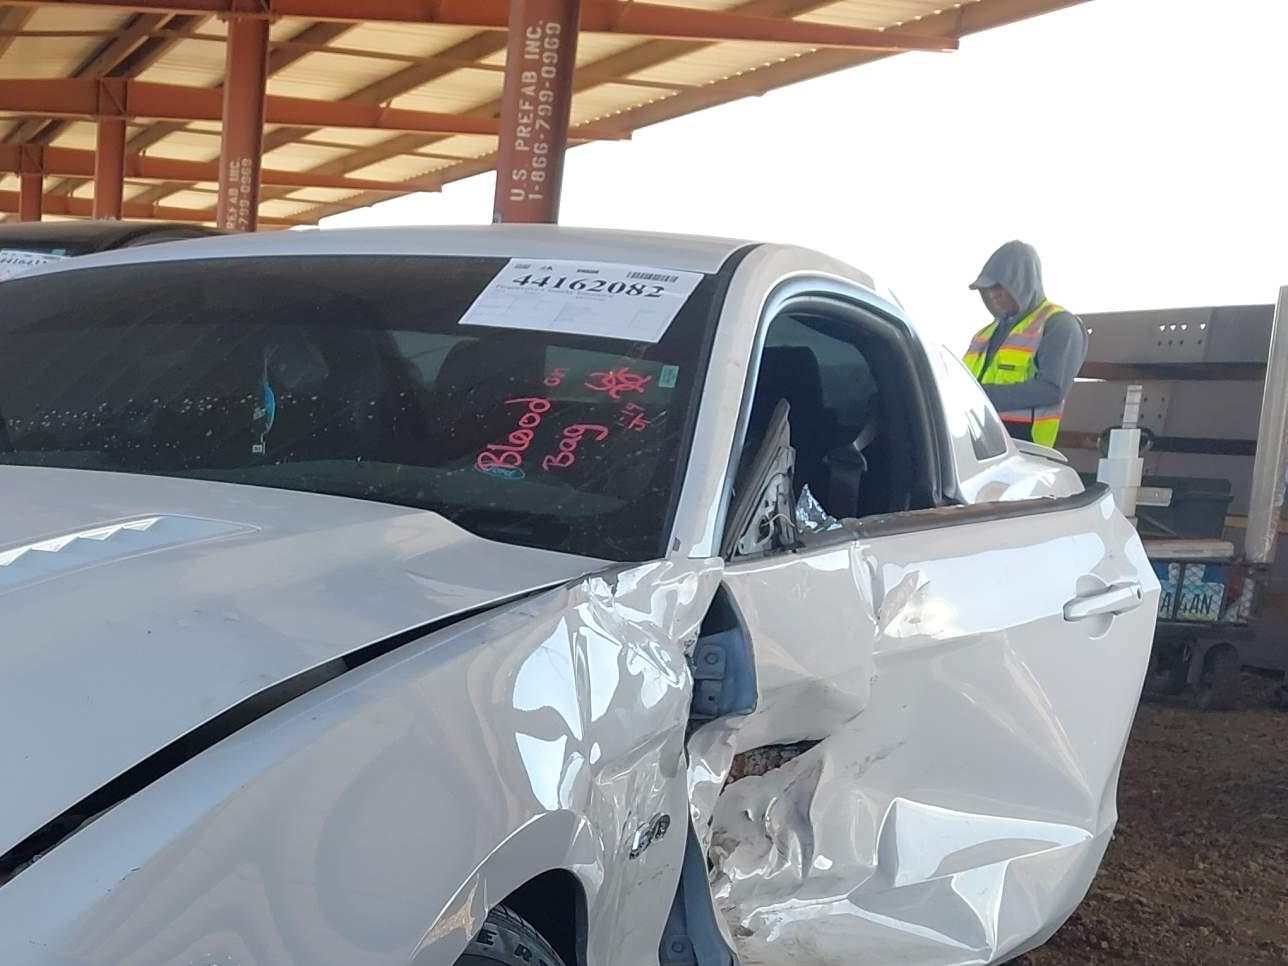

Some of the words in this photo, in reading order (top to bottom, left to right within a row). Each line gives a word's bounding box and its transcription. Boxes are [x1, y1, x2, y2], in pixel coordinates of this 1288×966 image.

[524, 20, 545, 60] INC.
[515, 70, 538, 151] PREFAB
[528, 22, 561, 200] 1-866-799-0969
[513, 273, 665, 298] 44162082
[477, 397, 552, 471] Blood
[542, 423, 609, 471] Bag
